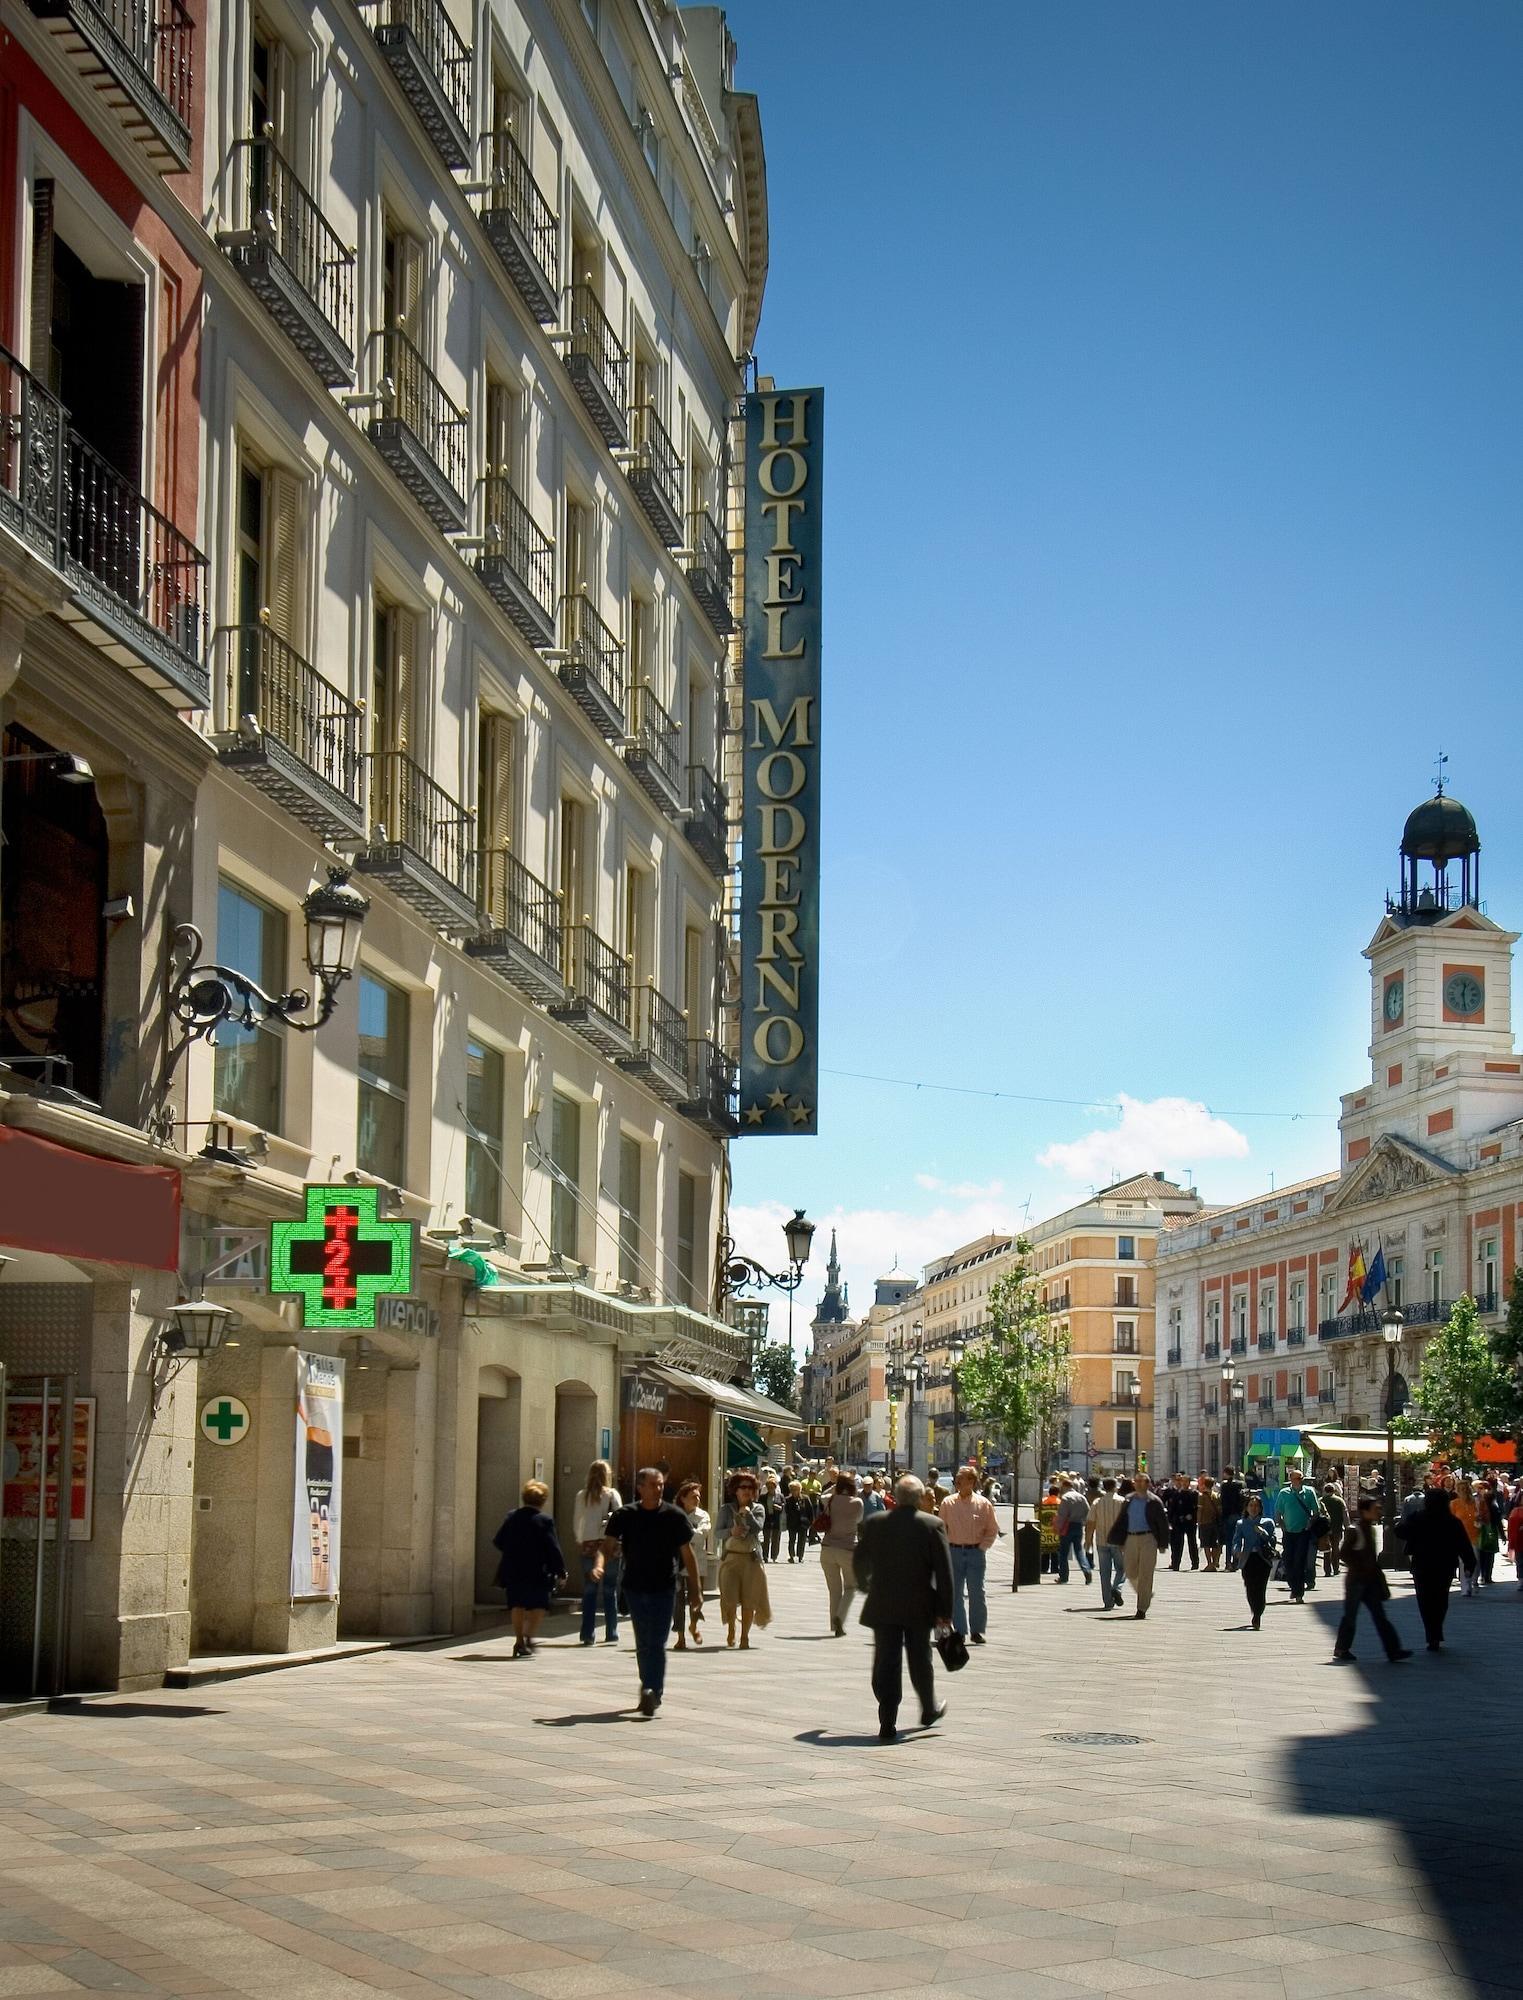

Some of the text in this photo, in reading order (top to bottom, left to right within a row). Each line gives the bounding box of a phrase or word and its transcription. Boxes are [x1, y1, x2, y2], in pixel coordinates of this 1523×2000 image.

[749, 394, 815, 1067] HOTEL MODERNO
[663, 1423, 697, 1438] Coimbra
